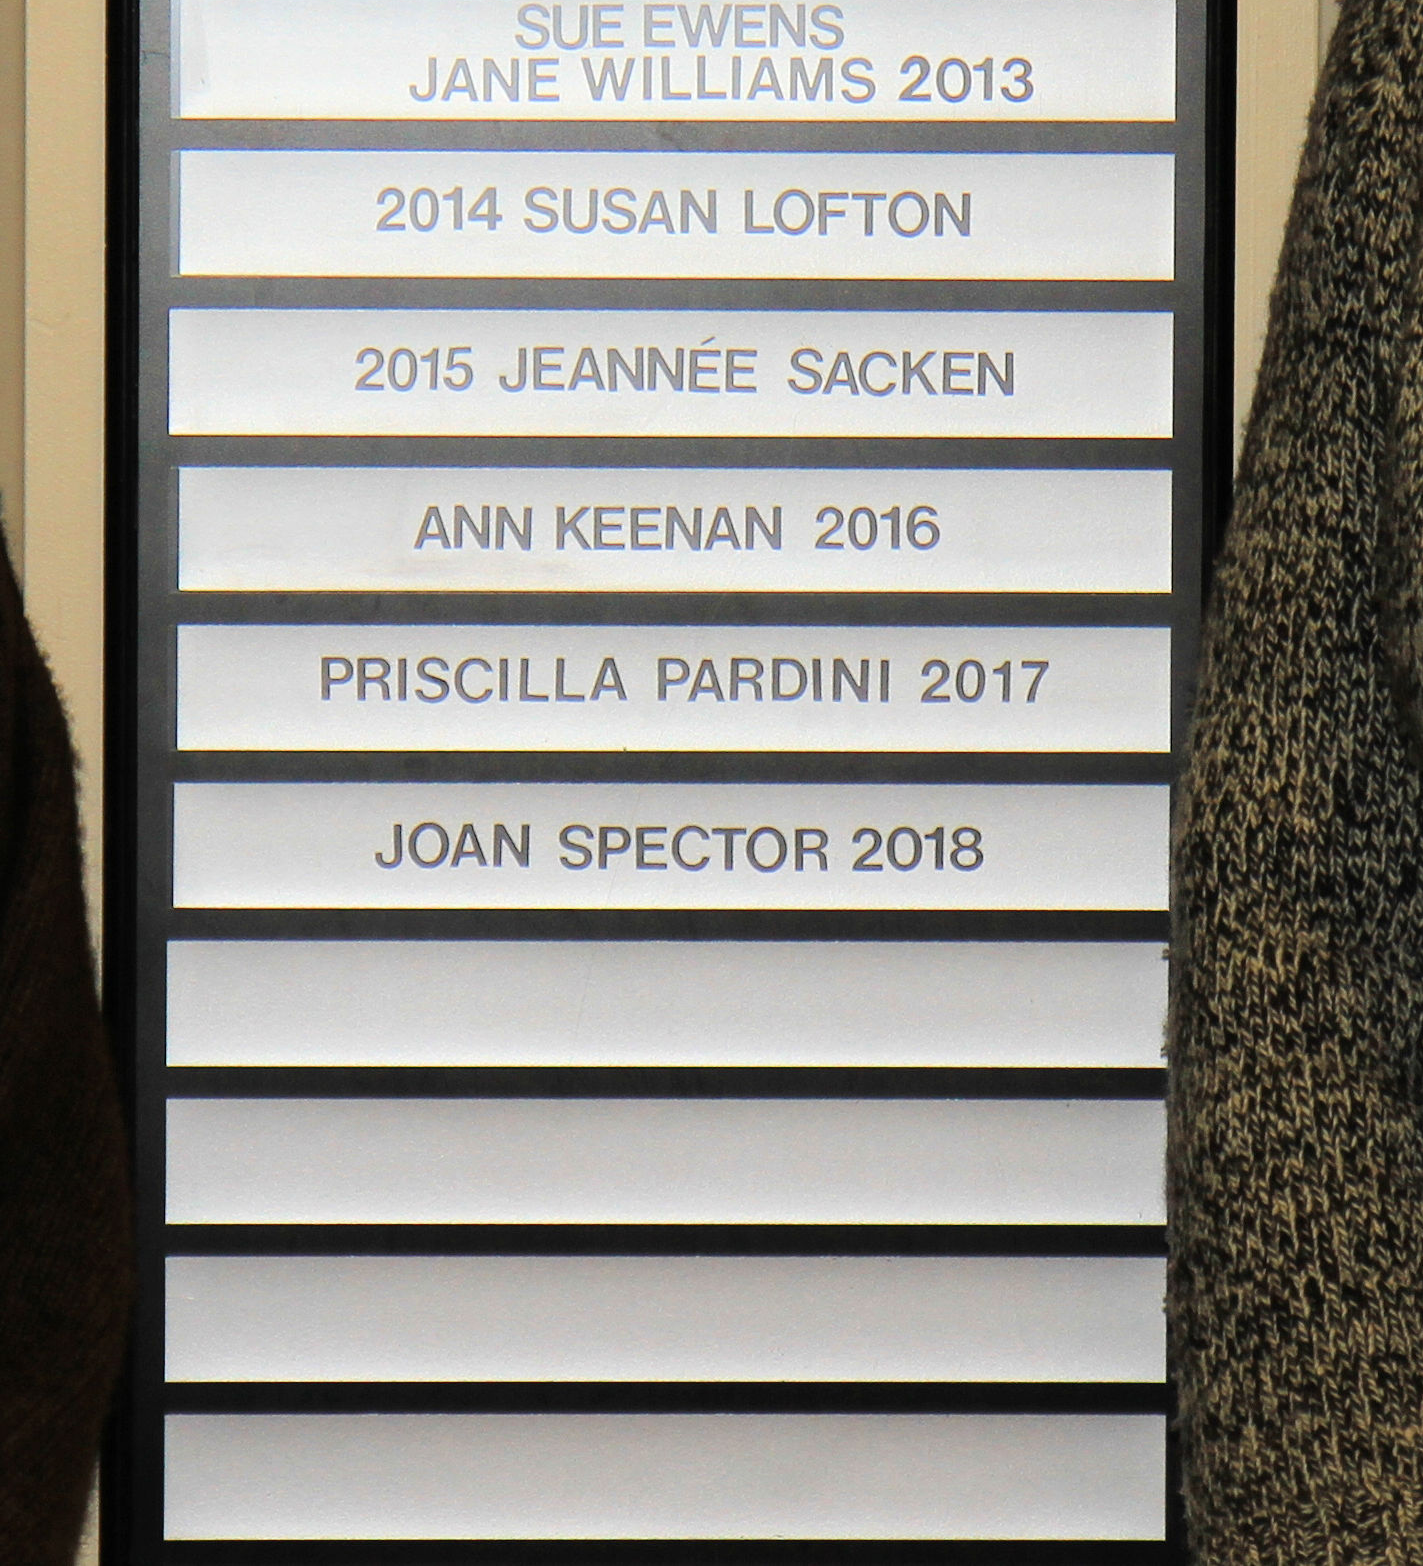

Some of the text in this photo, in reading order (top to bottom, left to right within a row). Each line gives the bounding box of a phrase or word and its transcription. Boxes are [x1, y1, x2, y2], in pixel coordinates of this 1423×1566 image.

[514, 1, 846, 51] SUE EWENS
[409, 56, 1035, 104] JANE WILLIAMS 2013
[375, 186, 974, 239] 2014 SUSAN LOFTON
[354, 336, 1017, 398] 2015 JEANNÉE SACKEN
[414, 505, 941, 554] ANN KEENAN 2016
[319, 655, 1051, 707] PRISCILLA PARDINI 2017
[374, 822, 985, 875] JOAN SPECTOR 2018
